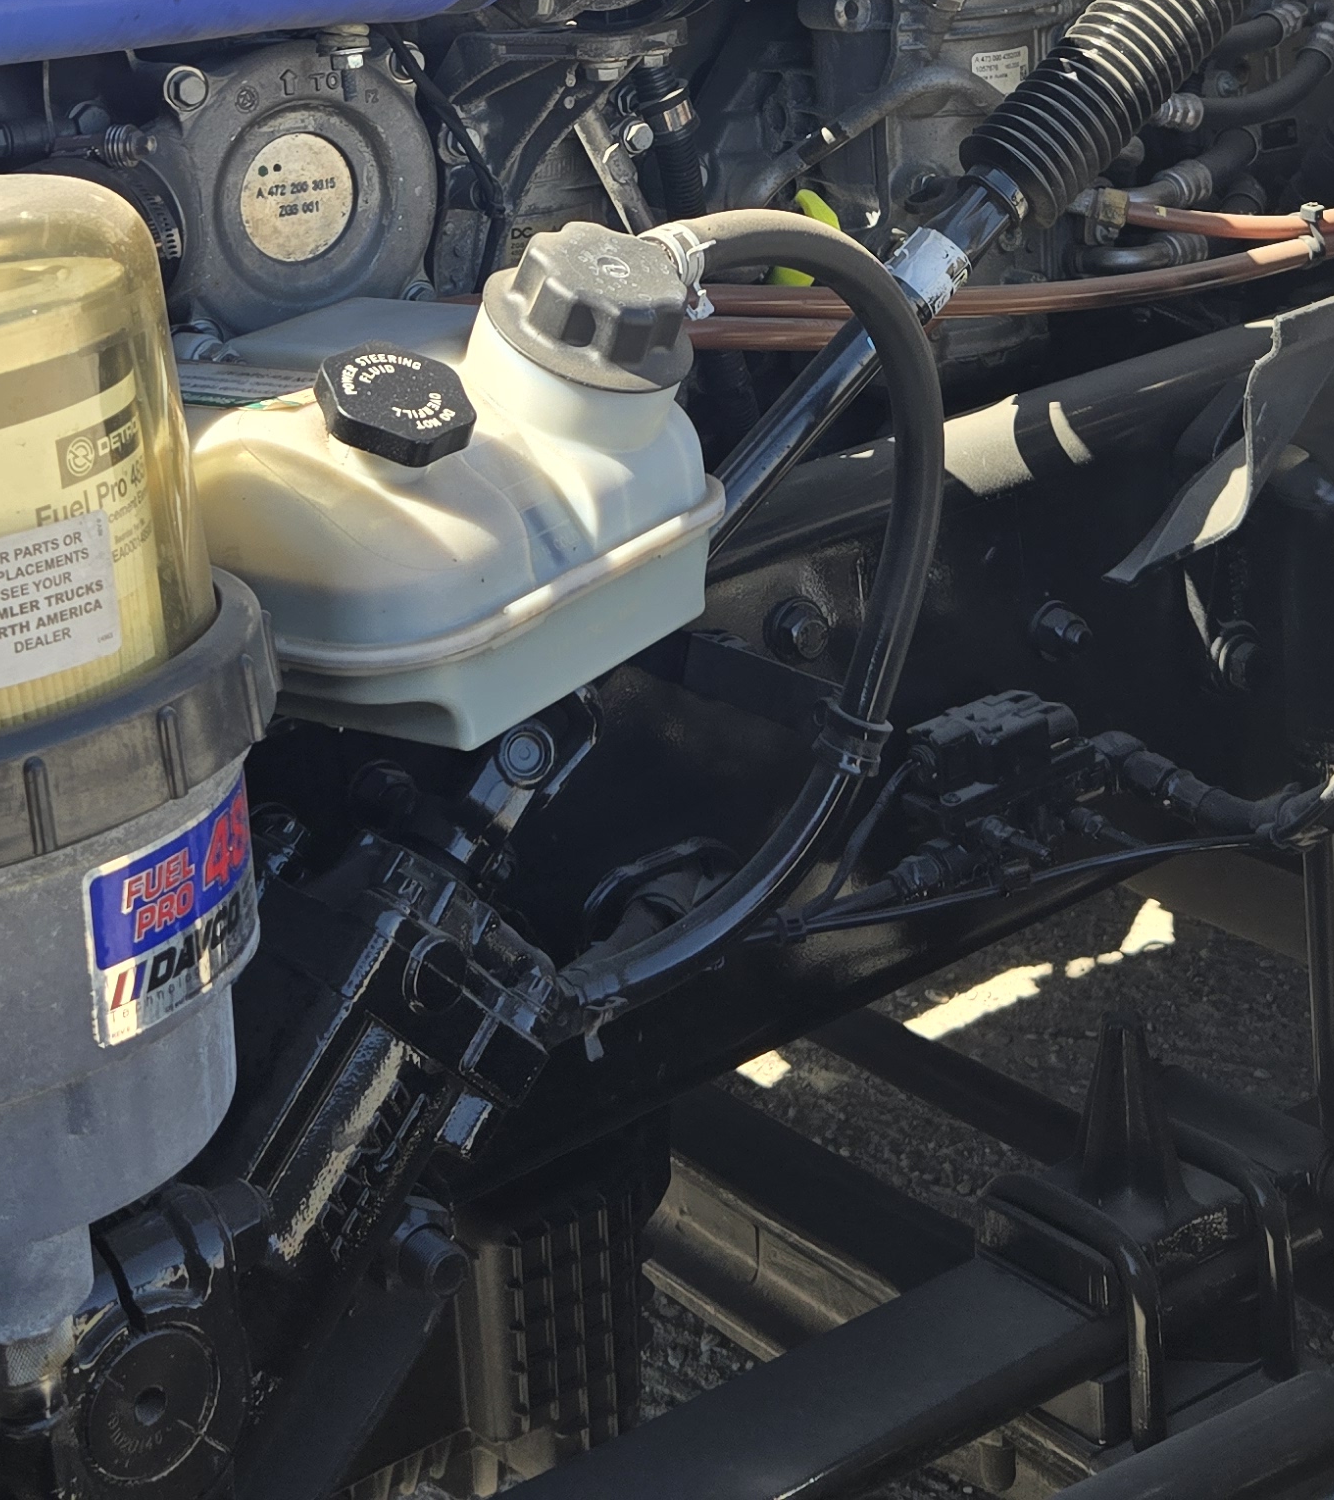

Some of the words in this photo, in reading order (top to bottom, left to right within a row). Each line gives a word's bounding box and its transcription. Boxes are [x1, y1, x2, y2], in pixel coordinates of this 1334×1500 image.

[256, 187, 264, 199] A
[268, 184, 287, 196] 472
[341, 365, 358, 395] POWER
[355, 354, 421, 370] STEERING
[359, 364, 395, 384] FLUID
[392, 392, 441, 419] OVERFILL
[439, 408, 455, 421] DO
[97, 418, 138, 457] DETRO
[416, 420, 442, 430] NOT
[35, 490, 91, 527] Fuel
[96, 478, 128, 510] Pro
[14, 538, 60, 561] PARTS
[63, 531, 83, 546] OR
[0, 583, 30, 601] SEE
[33, 571, 72, 593] YOUR
[44, 579, 104, 607] TRUCKS
[36, 598, 103, 630] AMERICA
[14, 627, 72, 654] DEALER
[121, 847, 195, 915] FUEL
[203, 794, 250, 891] 48
[134, 881, 194, 943] PRO
[147, 891, 240, 993] DAVCO
